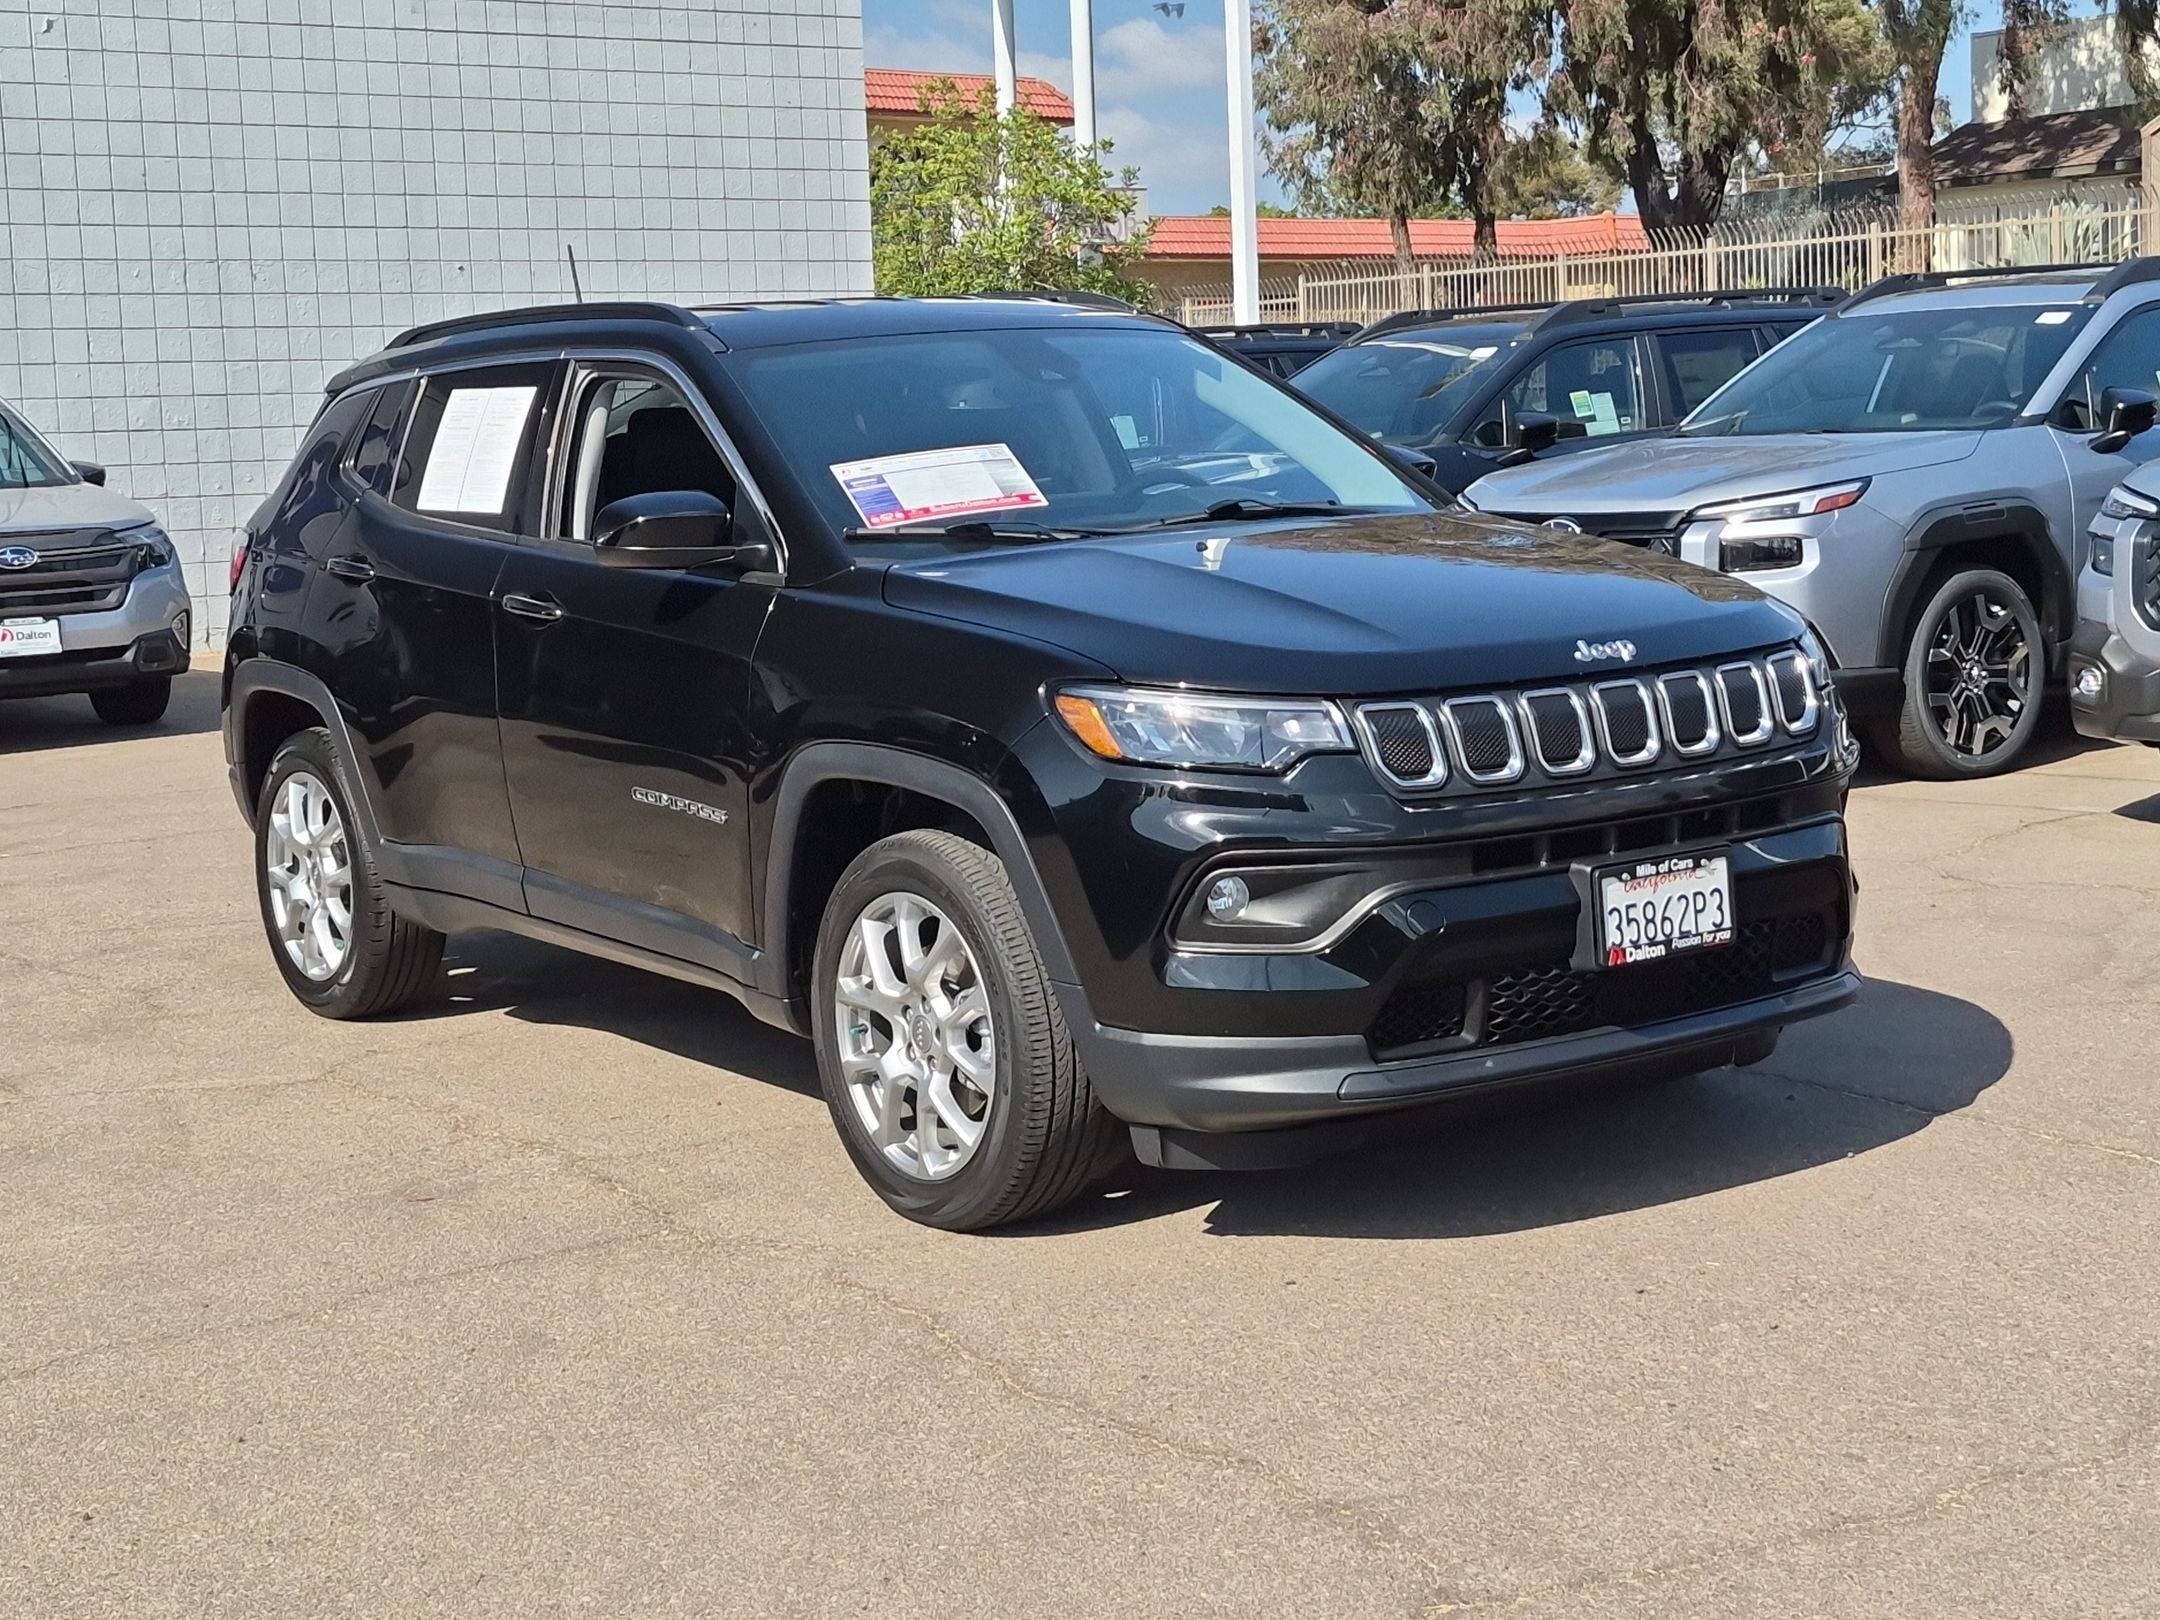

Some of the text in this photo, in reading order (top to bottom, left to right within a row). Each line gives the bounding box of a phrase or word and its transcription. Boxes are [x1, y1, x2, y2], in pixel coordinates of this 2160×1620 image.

[16, 630, 52, 641] Dalton
[1573, 639, 1637, 662] Jeep
[631, 786, 729, 825] COMPASS
[1636, 858, 1694, 878] Mile of Cars
[1608, 887, 1725, 947] 35862P3
[1702, 931, 1714, 944] for
[1715, 929, 1731, 943] you
[1625, 944, 1666, 963] Dalton
